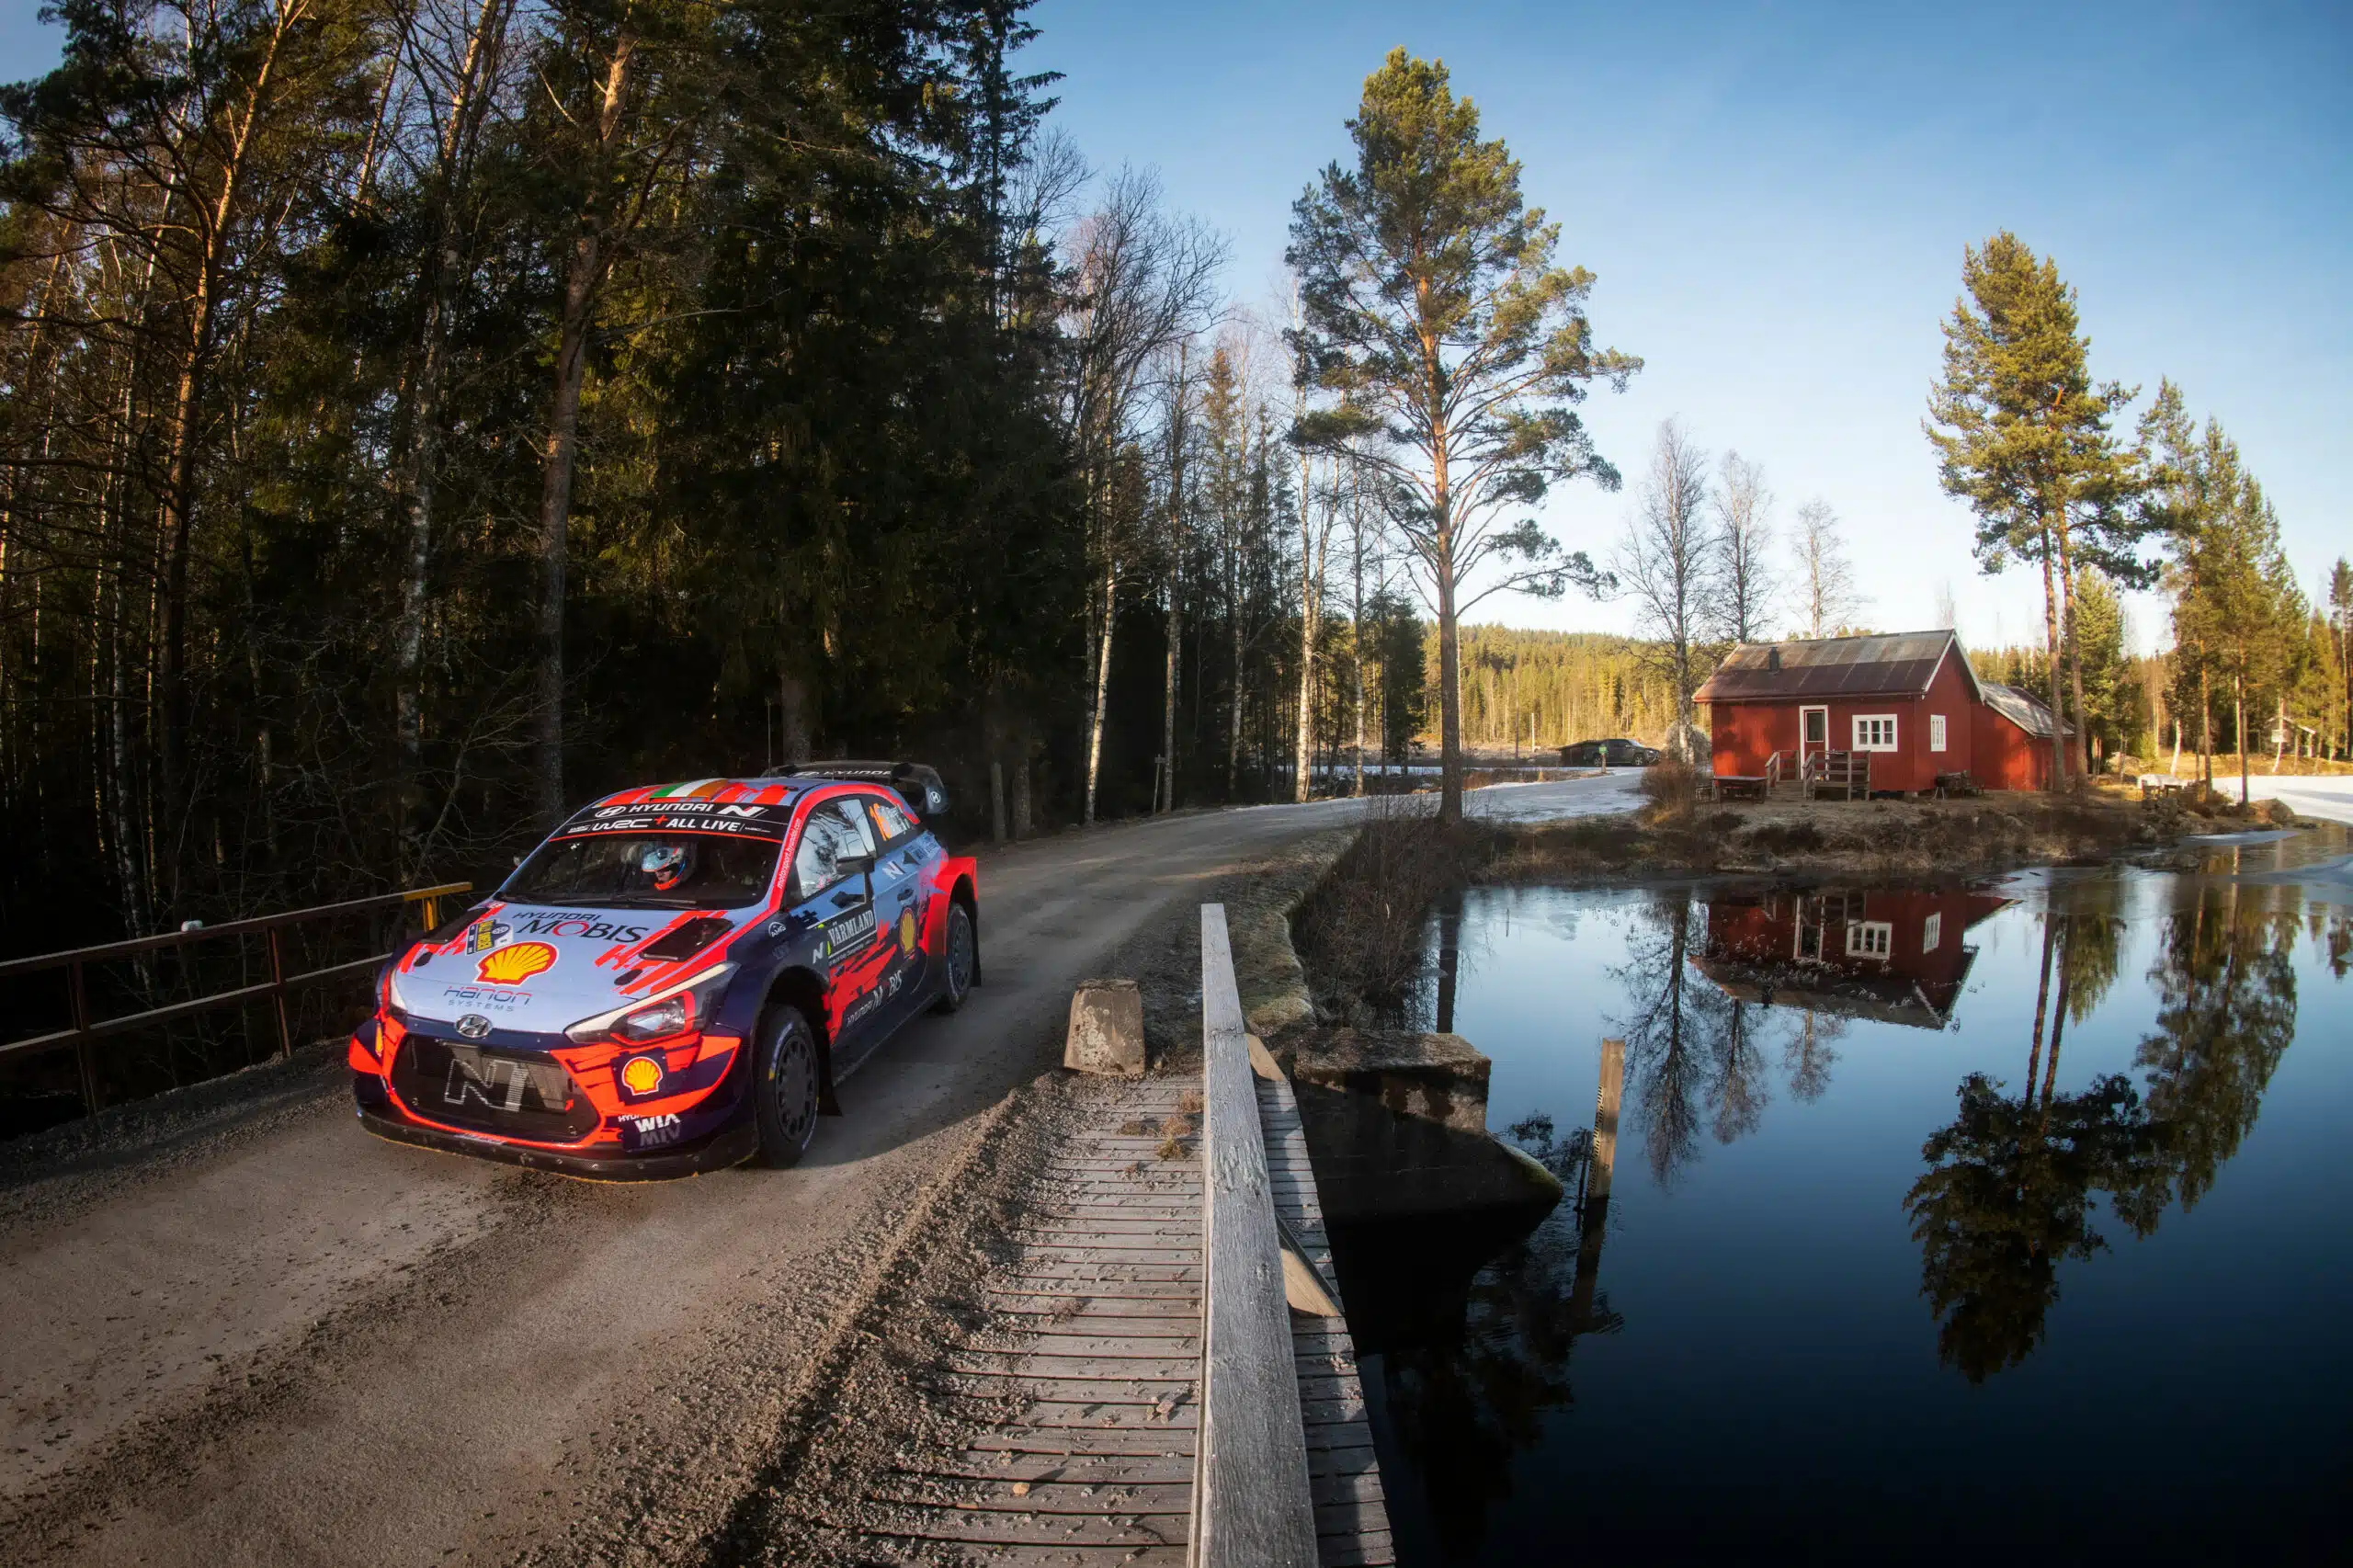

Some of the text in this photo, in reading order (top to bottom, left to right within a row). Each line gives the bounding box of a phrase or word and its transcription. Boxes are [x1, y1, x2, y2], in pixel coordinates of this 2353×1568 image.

[629, 803, 714, 812] HYUNDAI
[665, 818, 697, 828] ALL
[701, 819, 742, 832] LIVE
[512, 912, 602, 921] HYUNDAI
[516, 919, 650, 943] MOBIS
[827, 910, 874, 947] VÄRMLAND
[449, 999, 515, 1012] SYSTEMS
[634, 1113, 681, 1133] WIA
